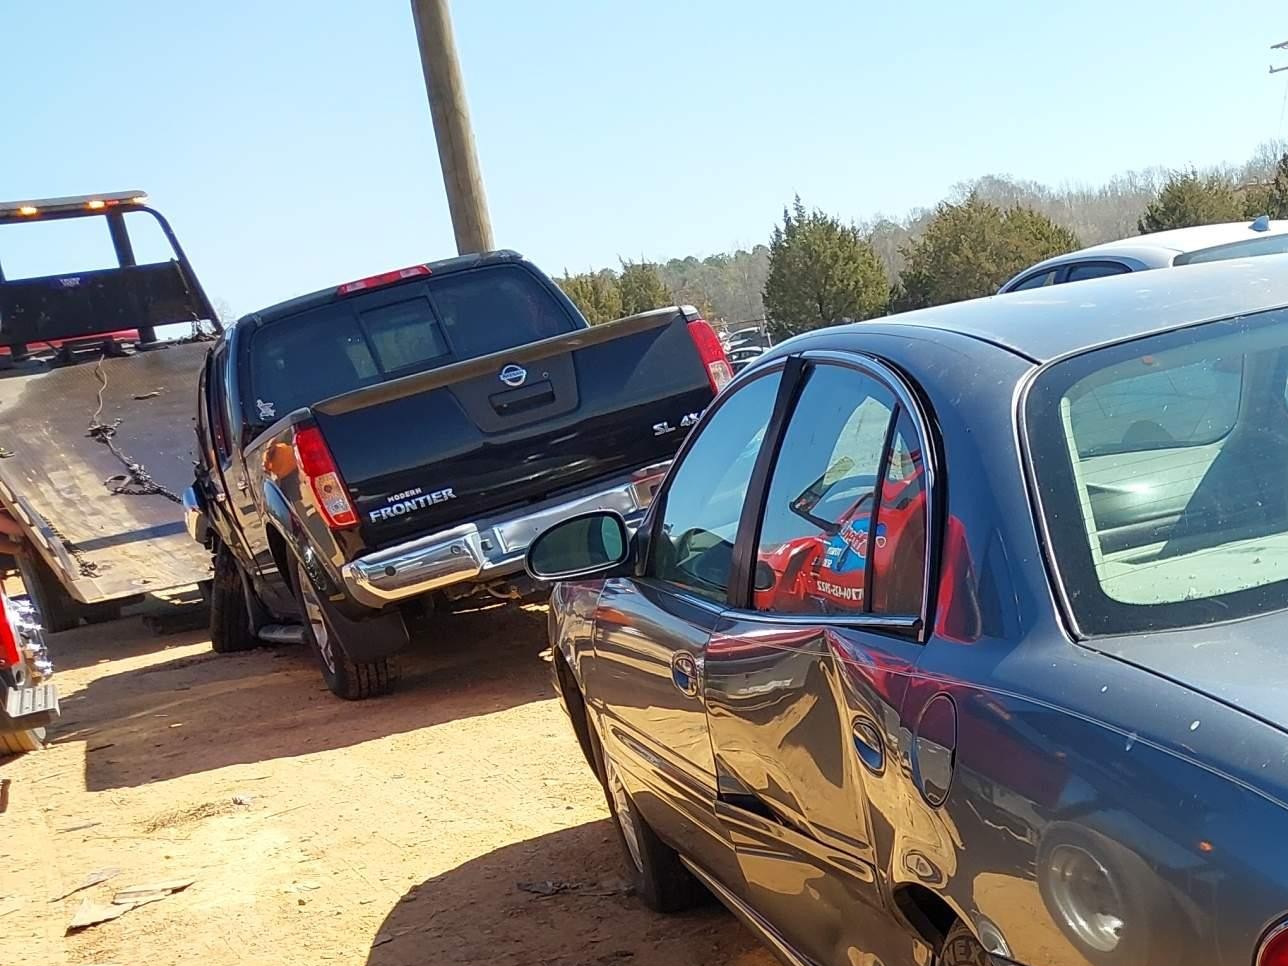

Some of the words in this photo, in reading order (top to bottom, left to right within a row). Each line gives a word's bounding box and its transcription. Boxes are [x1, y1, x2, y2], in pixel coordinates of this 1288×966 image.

[653, 421, 676, 436] SL
[680, 409, 705, 427] 4X
[369, 488, 456, 523] FRONTIER
[387, 488, 422, 503] MODERN
